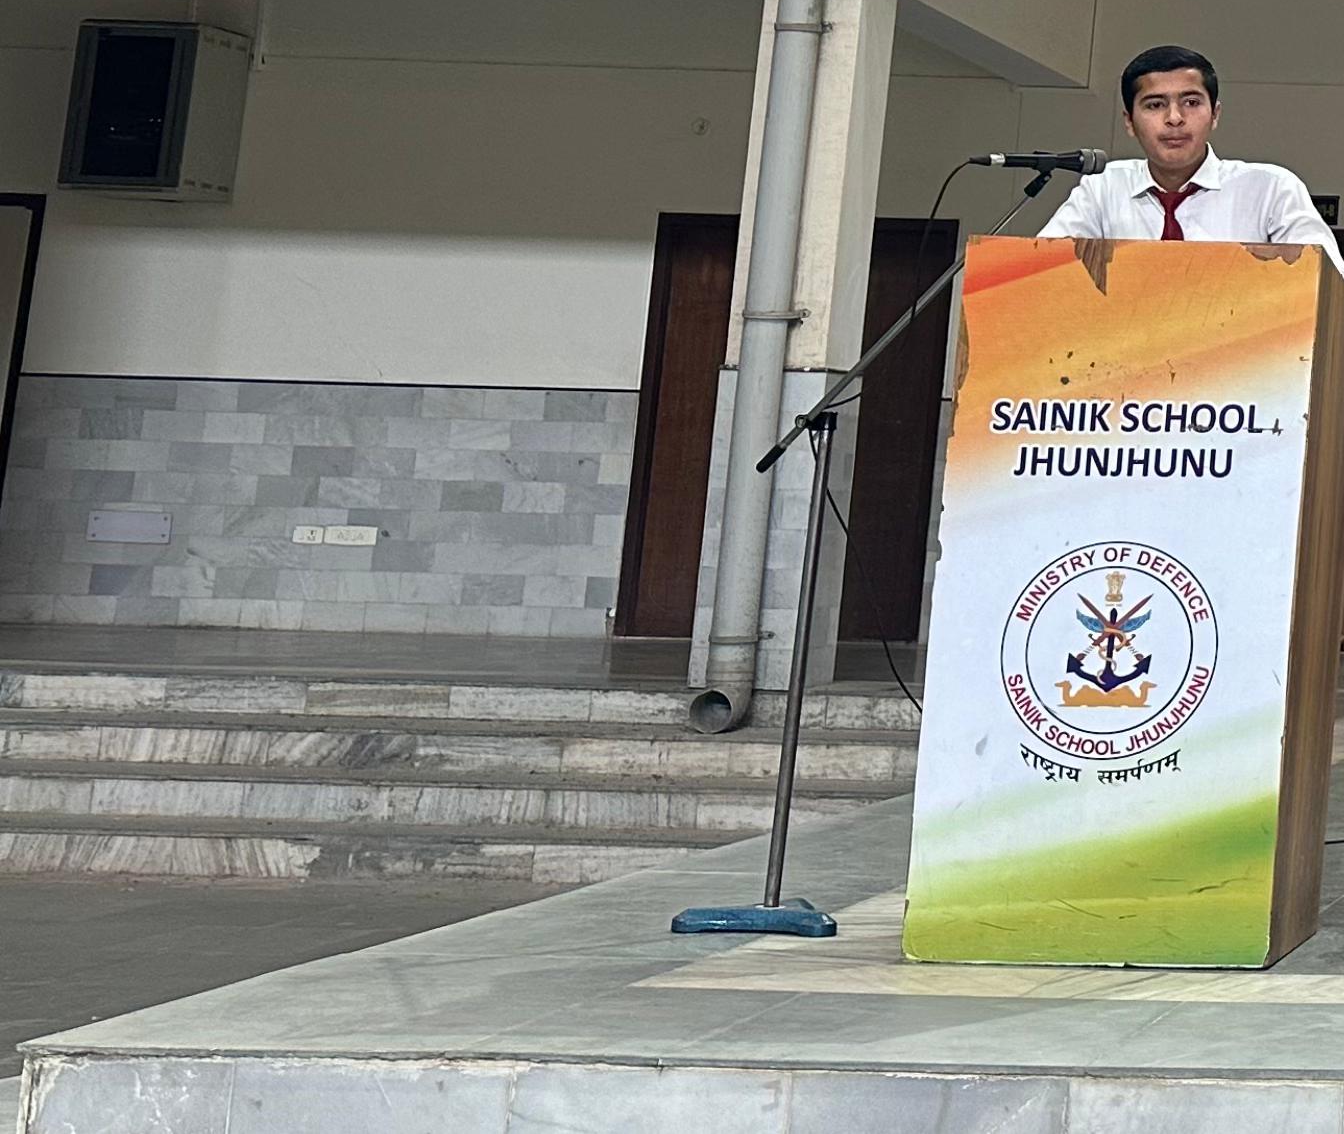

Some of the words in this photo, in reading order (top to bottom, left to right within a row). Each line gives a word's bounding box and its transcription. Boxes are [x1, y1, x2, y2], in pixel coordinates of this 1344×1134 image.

[992, 401, 1112, 433] SAINIK
[1120, 403, 1264, 434] SCHOOL
[1013, 446, 1234, 478] JHUNJHUNU
[1015, 550, 1096, 623] MINISTRY
[1104, 546, 1132, 563] OF
[1136, 551, 1210, 624] DEFENCE
[1008, 673, 1048, 733] SAINIK
[1045, 724, 1121, 756] SCHOOL
[1126, 665, 1210, 756] JHUNJHUNU
[1019, 743, 1082, 784] राष्ट्राय
[1097, 749, 1183, 785] समर्पणम्
